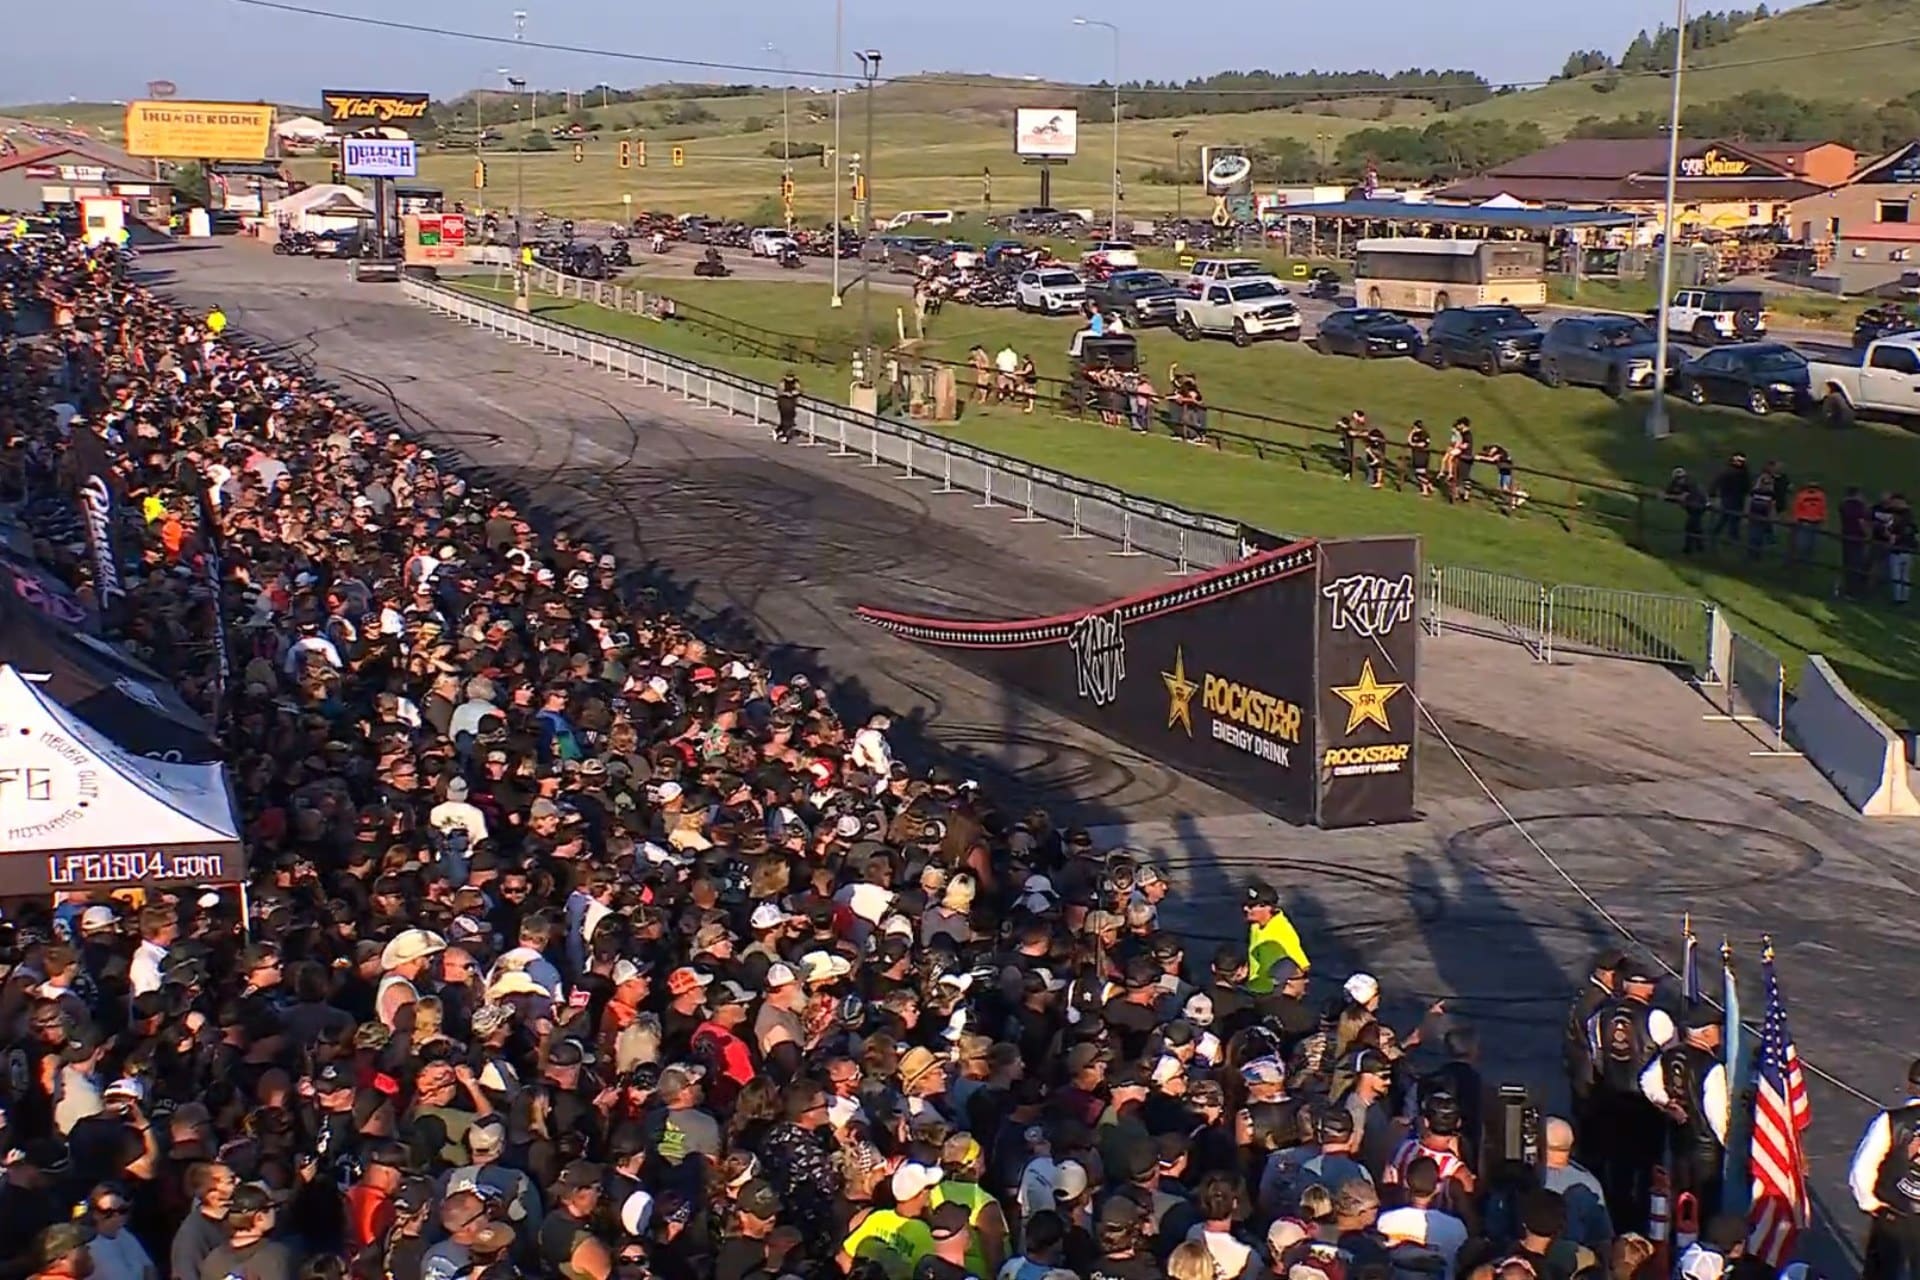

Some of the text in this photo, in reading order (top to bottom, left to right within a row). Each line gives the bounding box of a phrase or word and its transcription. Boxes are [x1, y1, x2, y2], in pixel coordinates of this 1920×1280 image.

[325, 97, 427, 121] Kick Start
[348, 145, 411, 167] DULUTH
[1203, 672, 1302, 743] ROCKSTAR
[1211, 719, 1290, 768] ENERGY DRINK
[1323, 743, 1411, 766] ROCKSTAR
